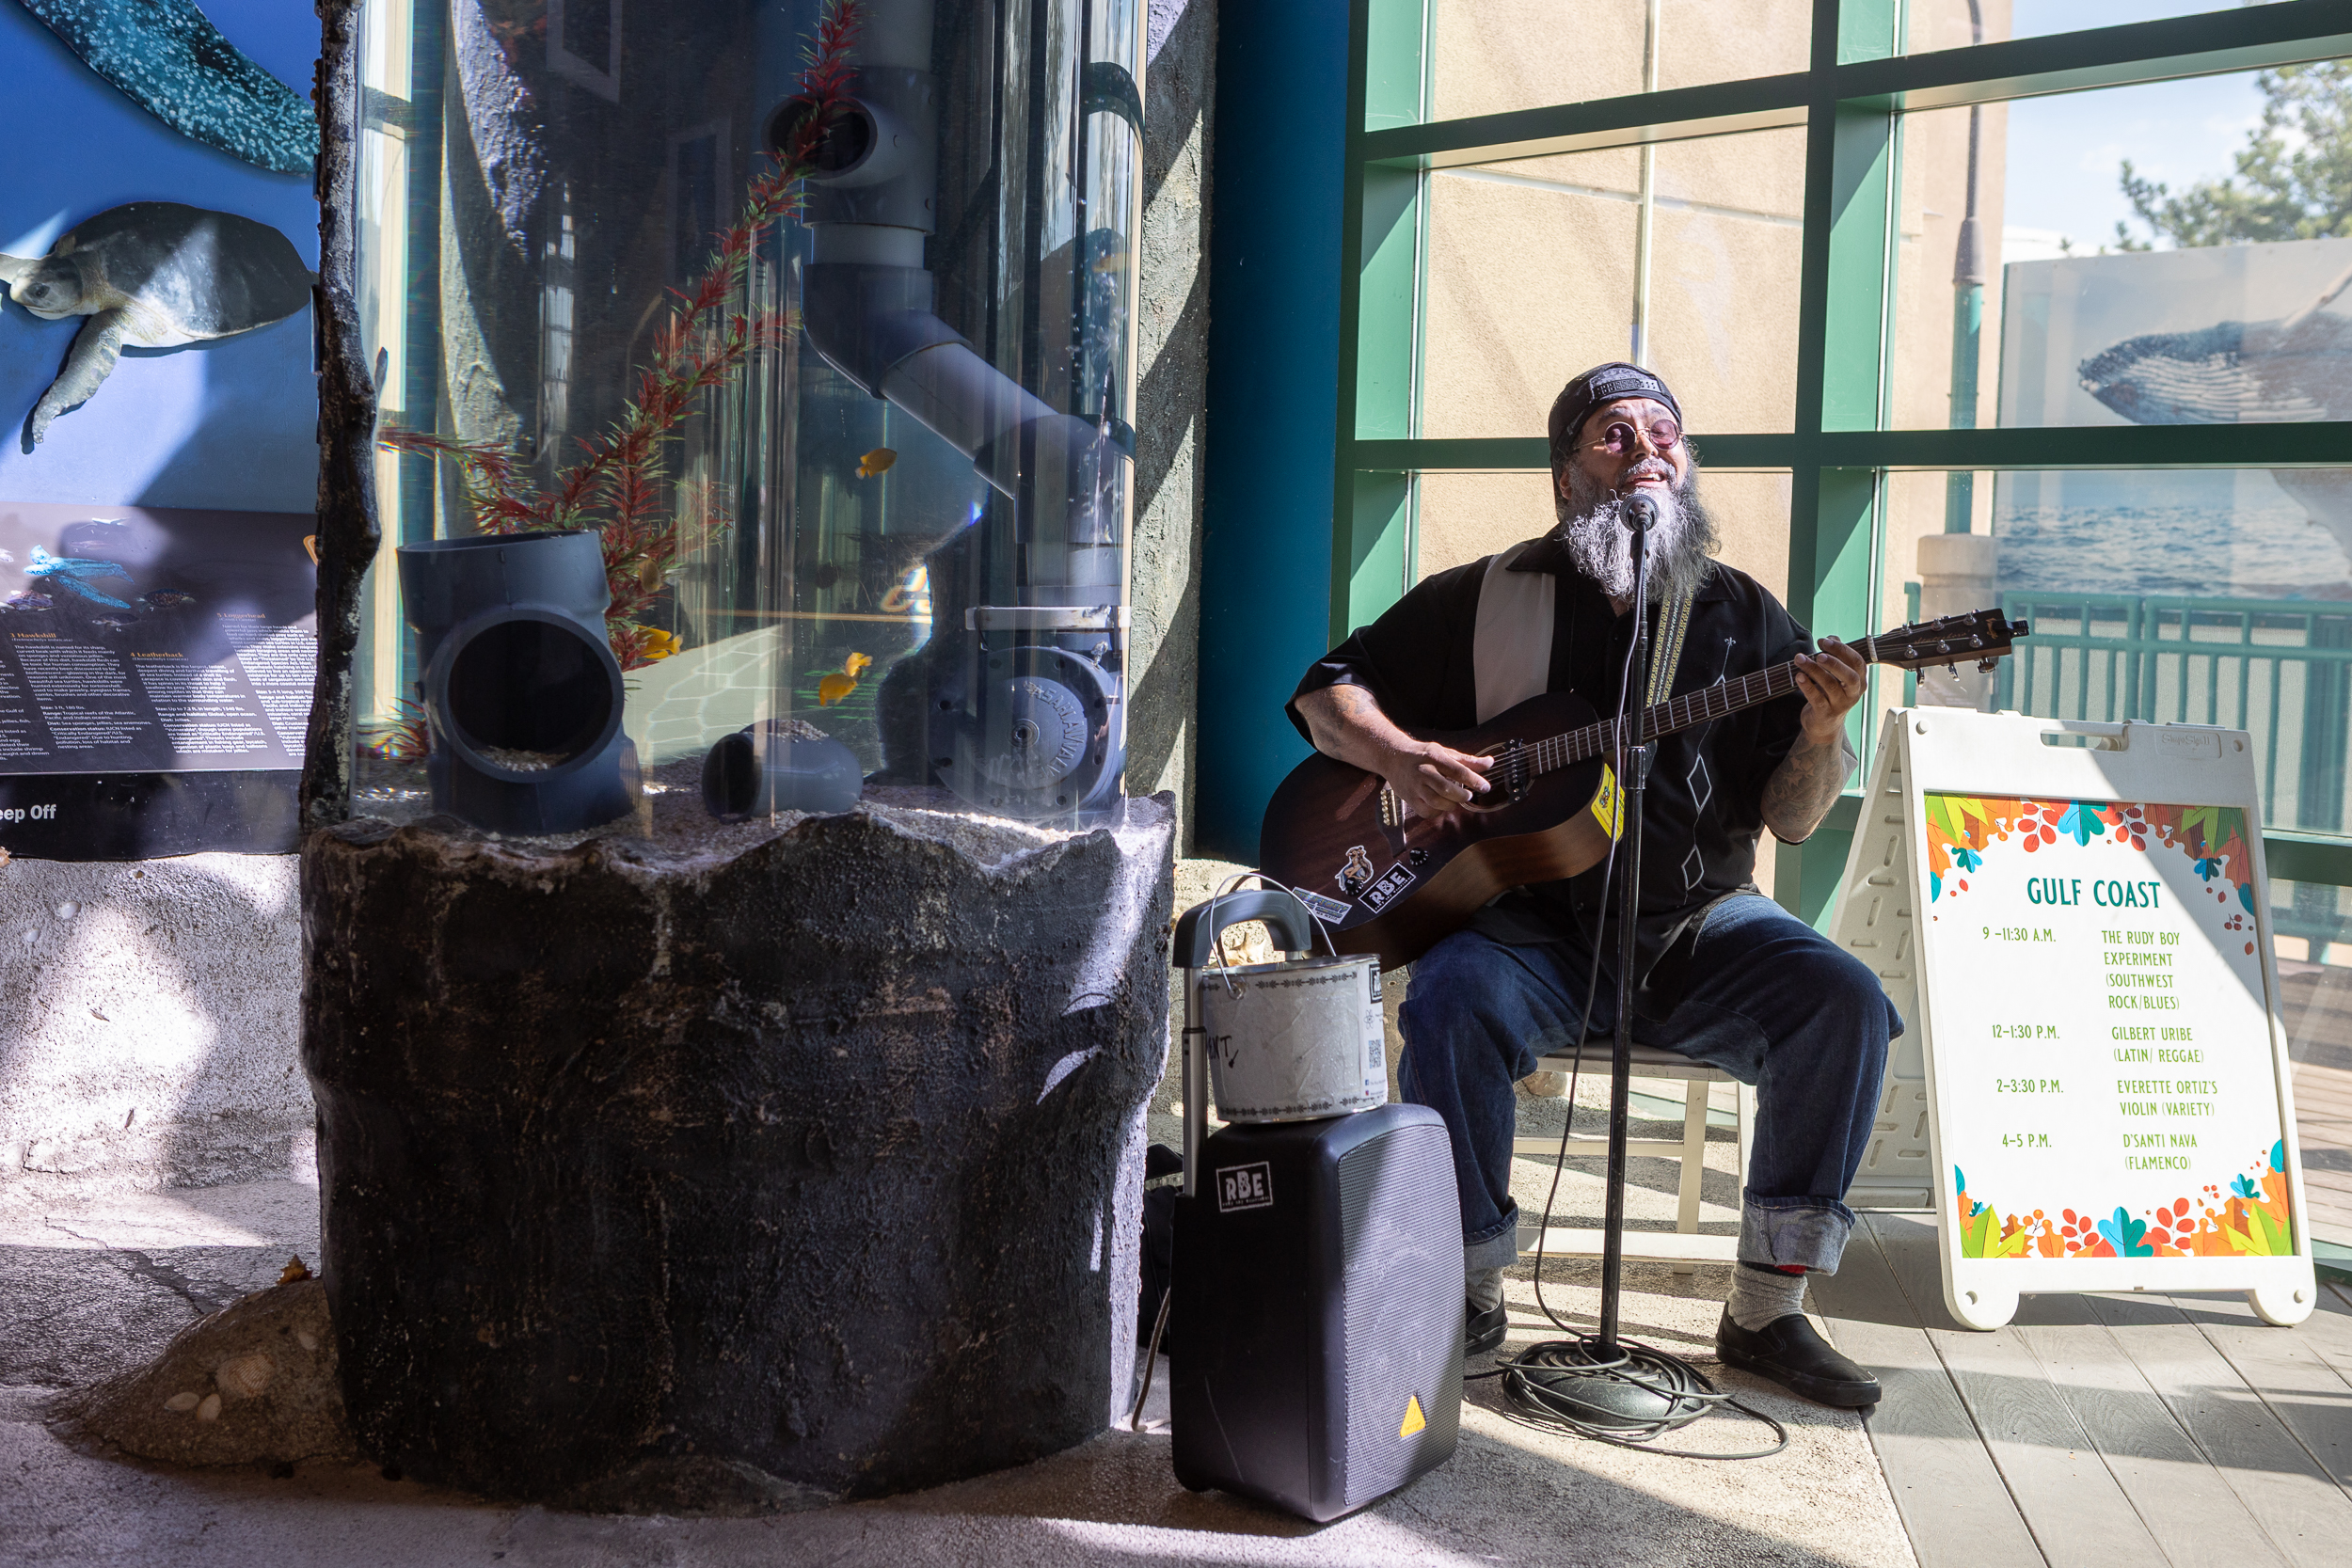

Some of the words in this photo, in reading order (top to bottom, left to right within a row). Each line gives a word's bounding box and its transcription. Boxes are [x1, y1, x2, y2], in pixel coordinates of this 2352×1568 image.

[30, 804, 56, 820] Off
[1369, 870, 1407, 904] RBE
[2027, 878, 2081, 905] GULF
[2093, 880, 2160, 908] COAST
[1983, 927, 1989, 939] 9
[2034, 928, 2056, 942] A.M.
[2102, 931, 2122, 943] THE
[2127, 931, 2153, 944] RUDY
[2160, 932, 2179, 945] BOY
[2105, 953, 2172, 966] EXPERIMENT
[2106, 974, 2172, 988] (SOUTHWEST
[2109, 996, 2179, 1009] ROCK/BLUES)
[2037, 1026, 2059, 1038] P.M.
[2112, 1027, 2155, 1040] GILBERT
[2161, 1028, 2192, 1040] URIBE
[2114, 1049, 2152, 1063] (LATIN/
[2159, 1050, 2203, 1062] REGGAE)
[2041, 1080, 2063, 1092] P.M.
[2118, 1081, 2171, 1093] EVERETTE
[2177, 1081, 2217, 1094] ORTIZ'S
[2121, 1102, 2157, 1116] VIOLIN
[2162, 1103, 2214, 1116] (VARIETY)
[2028, 1134, 2051, 1147] P.M.
[2123, 1134, 2165, 1148] D'SANTI
[2170, 1134, 2197, 1147] NAVA
[2125, 1157, 2190, 1169] (FLAMENCO)
[1225, 1170, 1264, 1201] RBE
